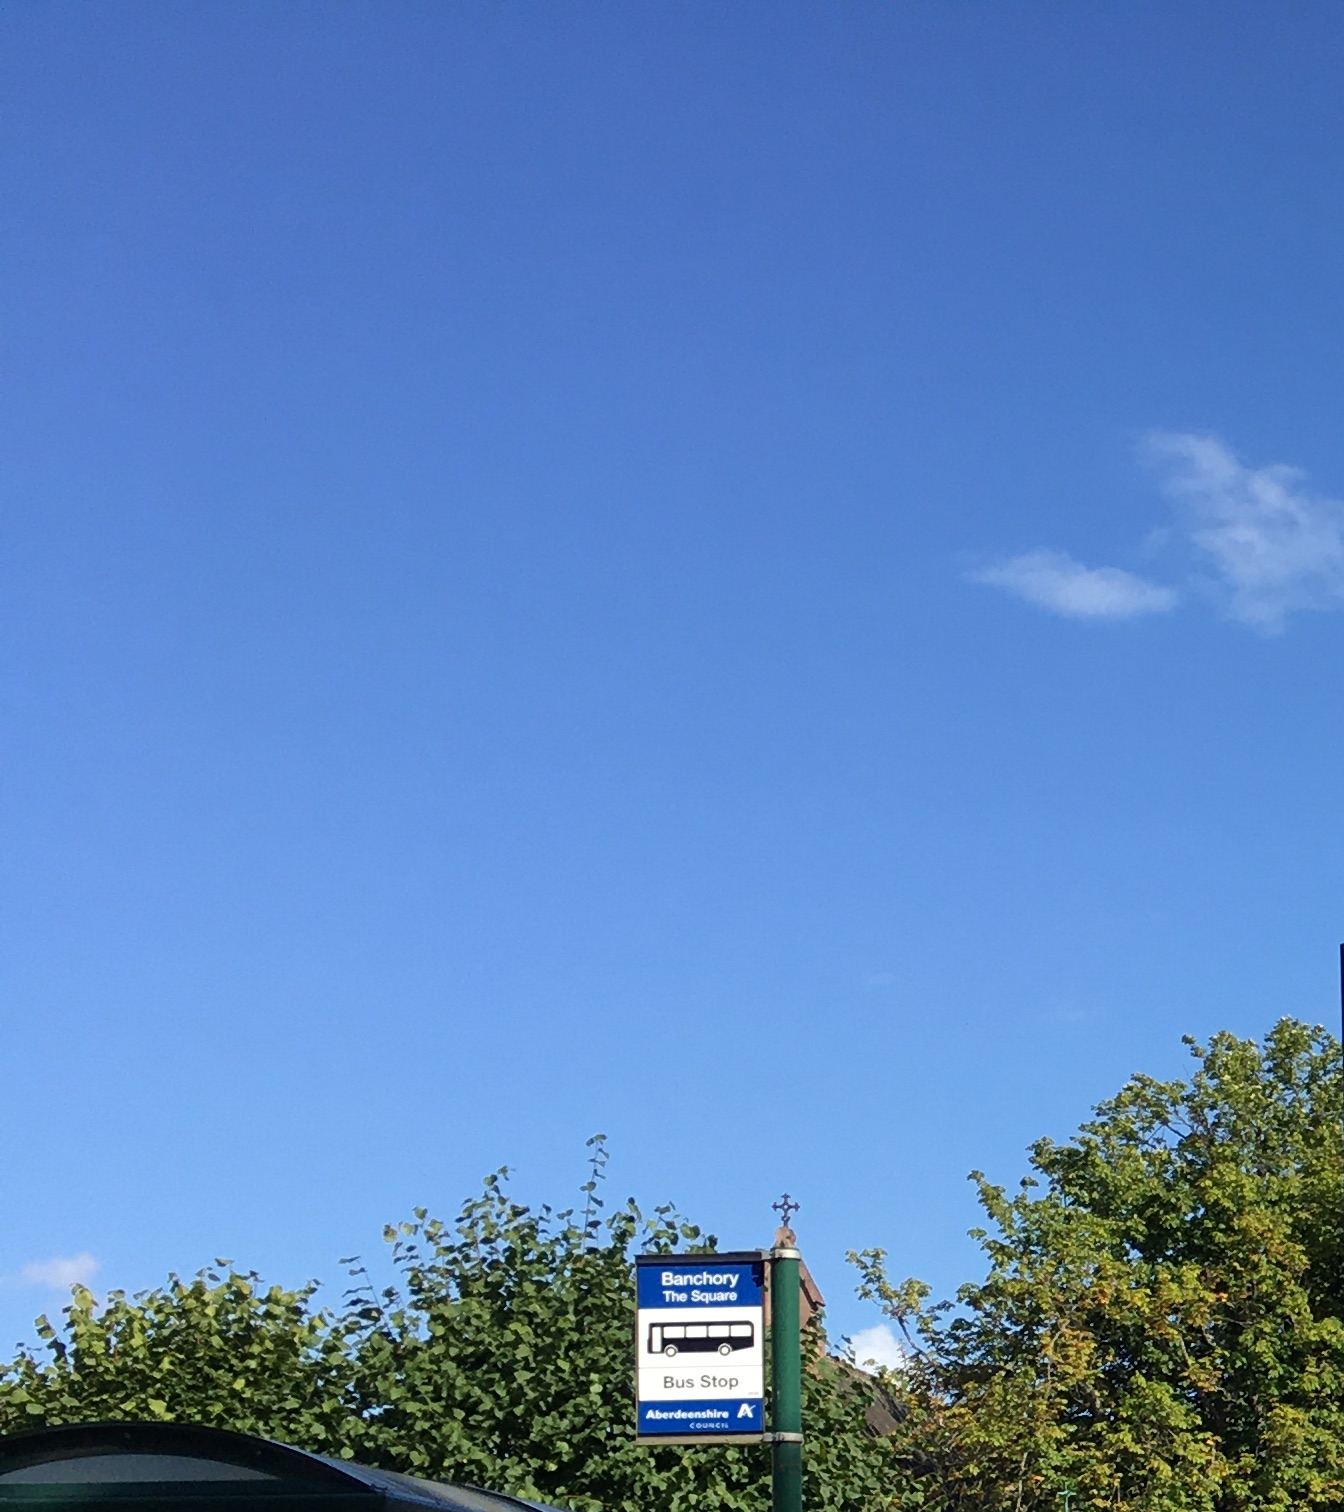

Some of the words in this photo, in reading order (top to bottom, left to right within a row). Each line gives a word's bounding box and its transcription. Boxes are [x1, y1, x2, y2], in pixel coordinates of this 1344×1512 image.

[661, 1271, 740, 1288] Banchory
[662, 1290, 688, 1302] The
[691, 1289, 738, 1304] Square
[663, 1376, 695, 1389] Bus
[700, 1374, 739, 1390] Stop
[645, 1408, 730, 1420] Aberdeenshire
[689, 1421, 729, 1429] COUNCIL
